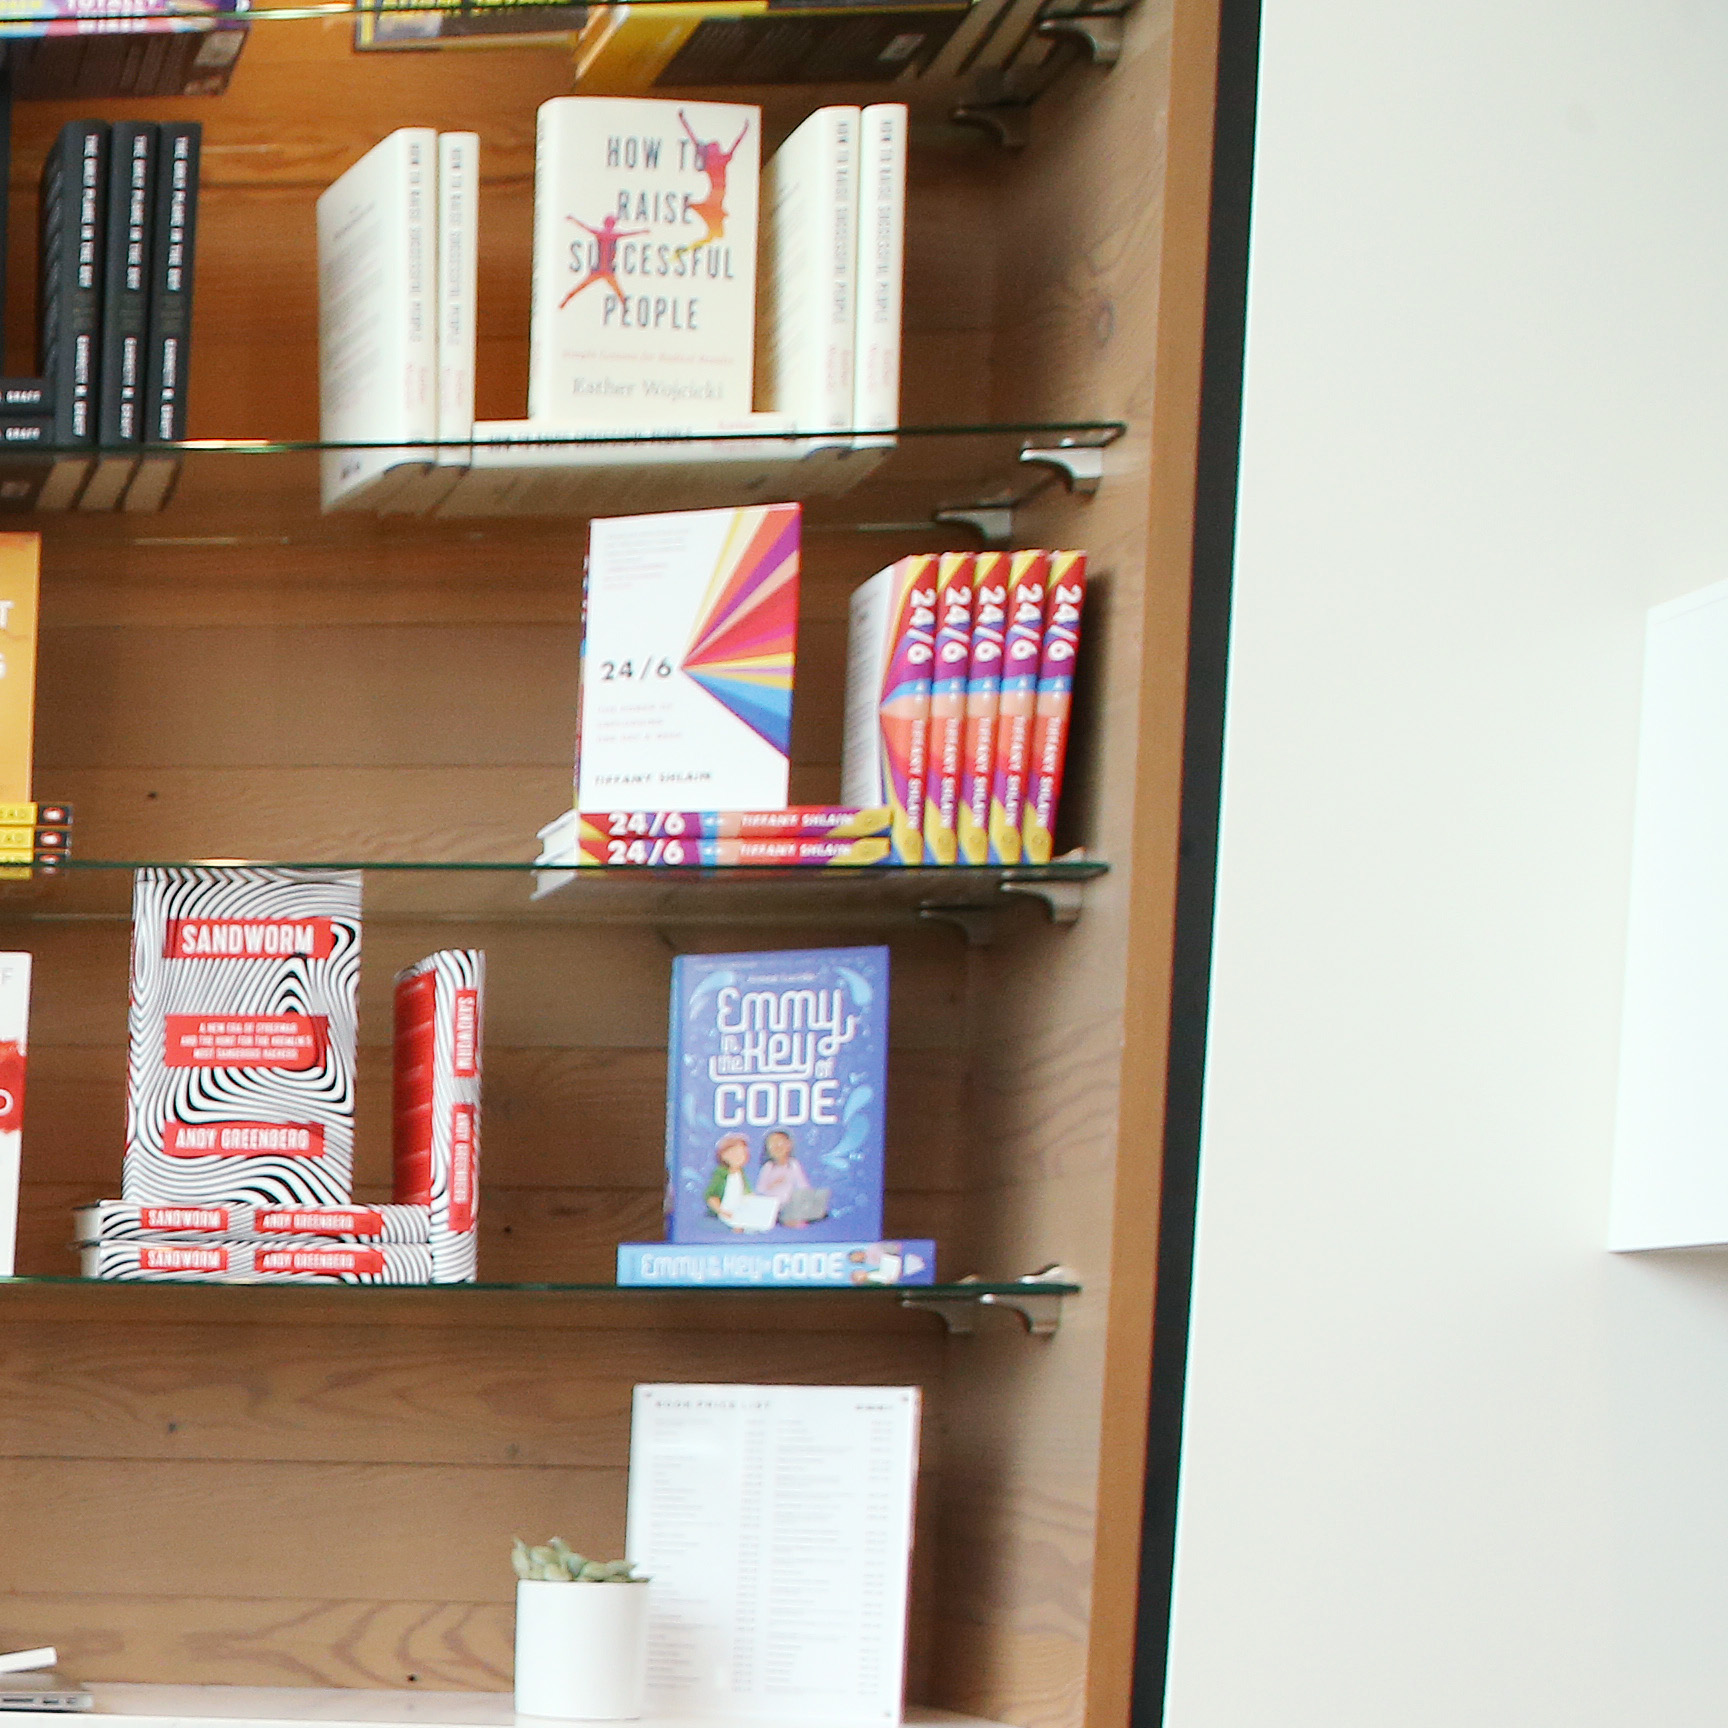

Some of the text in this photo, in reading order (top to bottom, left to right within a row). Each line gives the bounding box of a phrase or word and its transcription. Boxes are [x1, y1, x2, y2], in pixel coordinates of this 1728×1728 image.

[608, 135, 662, 169] HOW
[617, 189, 696, 224] RAISE
[569, 240, 734, 279] SUCCESSFUL
[603, 295, 698, 329] PEOPLE
[601, 657, 672, 681] 24/6
[608, 811, 686, 837] 24/6
[607, 839, 685, 865] 24/6
[181, 924, 314, 955] SANDWORM
[717, 987, 856, 1055] Emmy
[714, 1079, 840, 1127] CODE
[175, 1128, 310, 1150] ANDY GREENBERG
